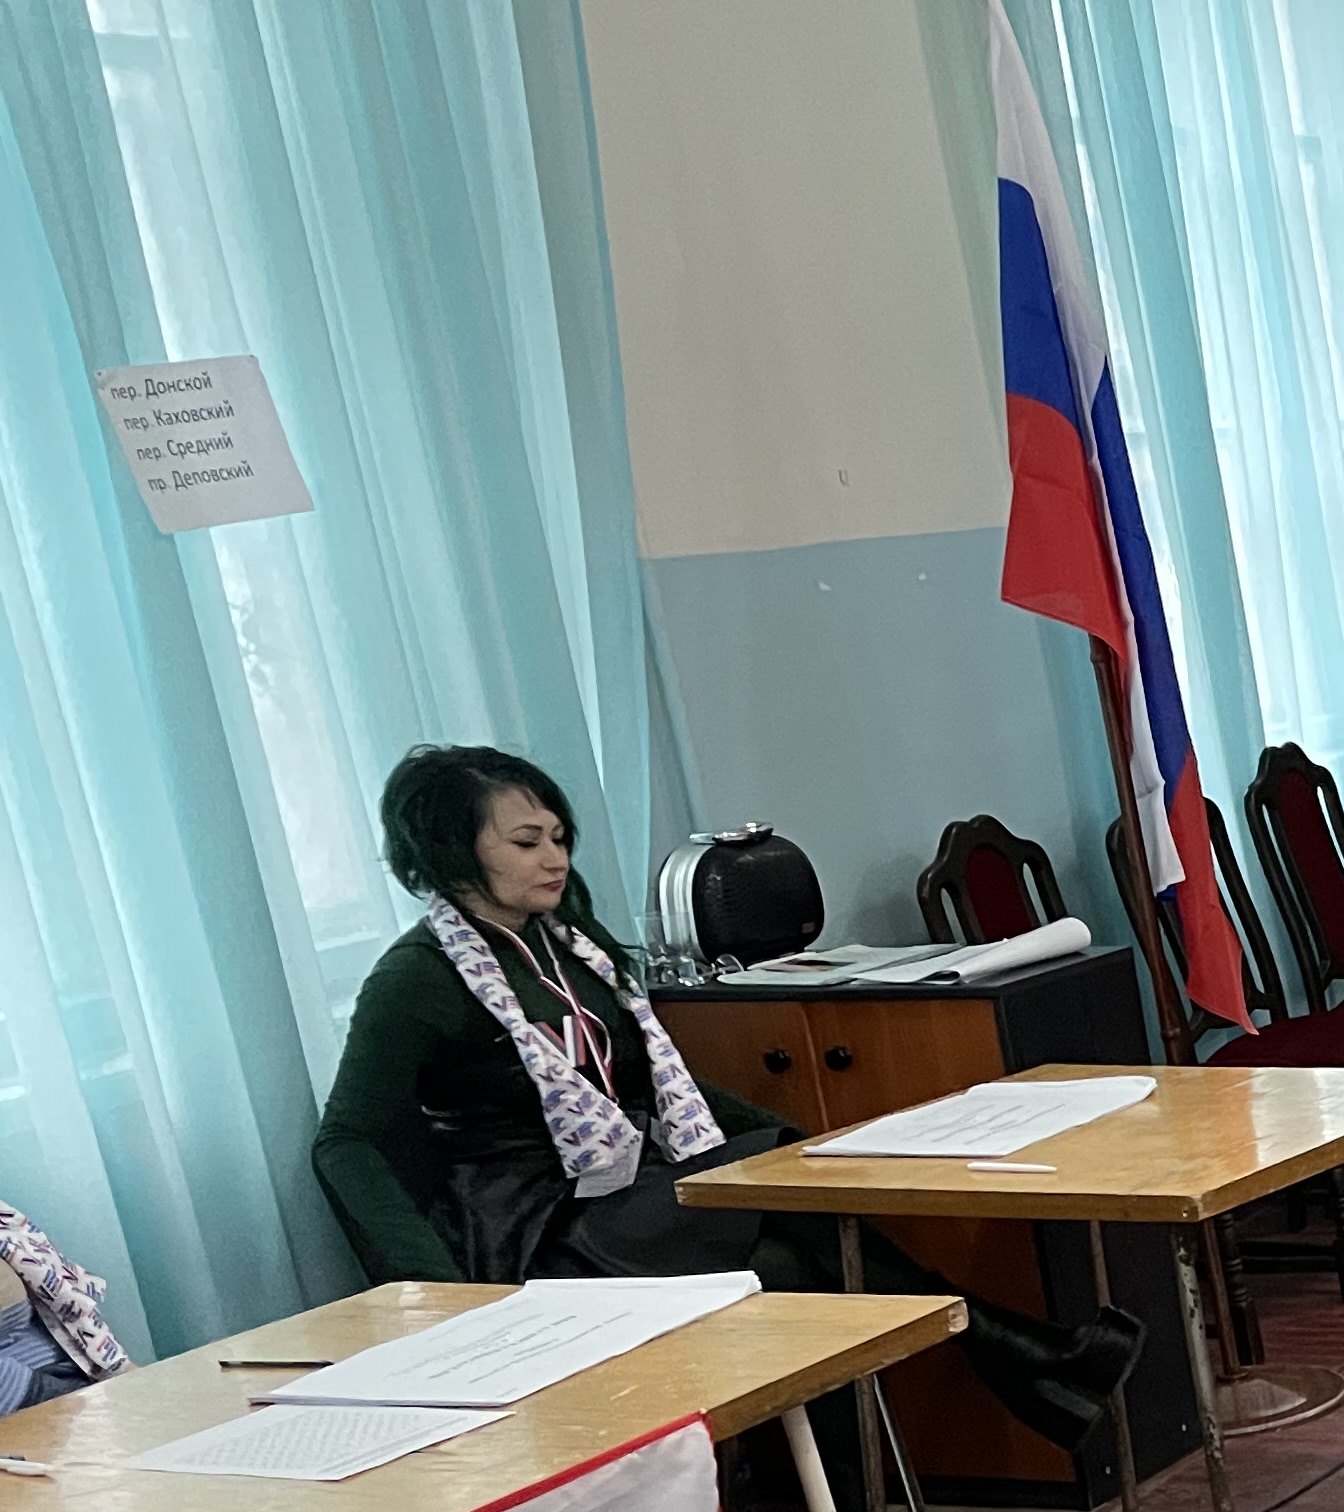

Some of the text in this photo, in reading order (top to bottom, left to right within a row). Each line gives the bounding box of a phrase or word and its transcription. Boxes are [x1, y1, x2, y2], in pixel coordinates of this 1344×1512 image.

[111, 370, 213, 400] пер. Донской
[123, 400, 235, 431] пер. Каховский
[136, 430, 234, 460] пер. Средний
[147, 460, 254, 493] пр. Деповский
